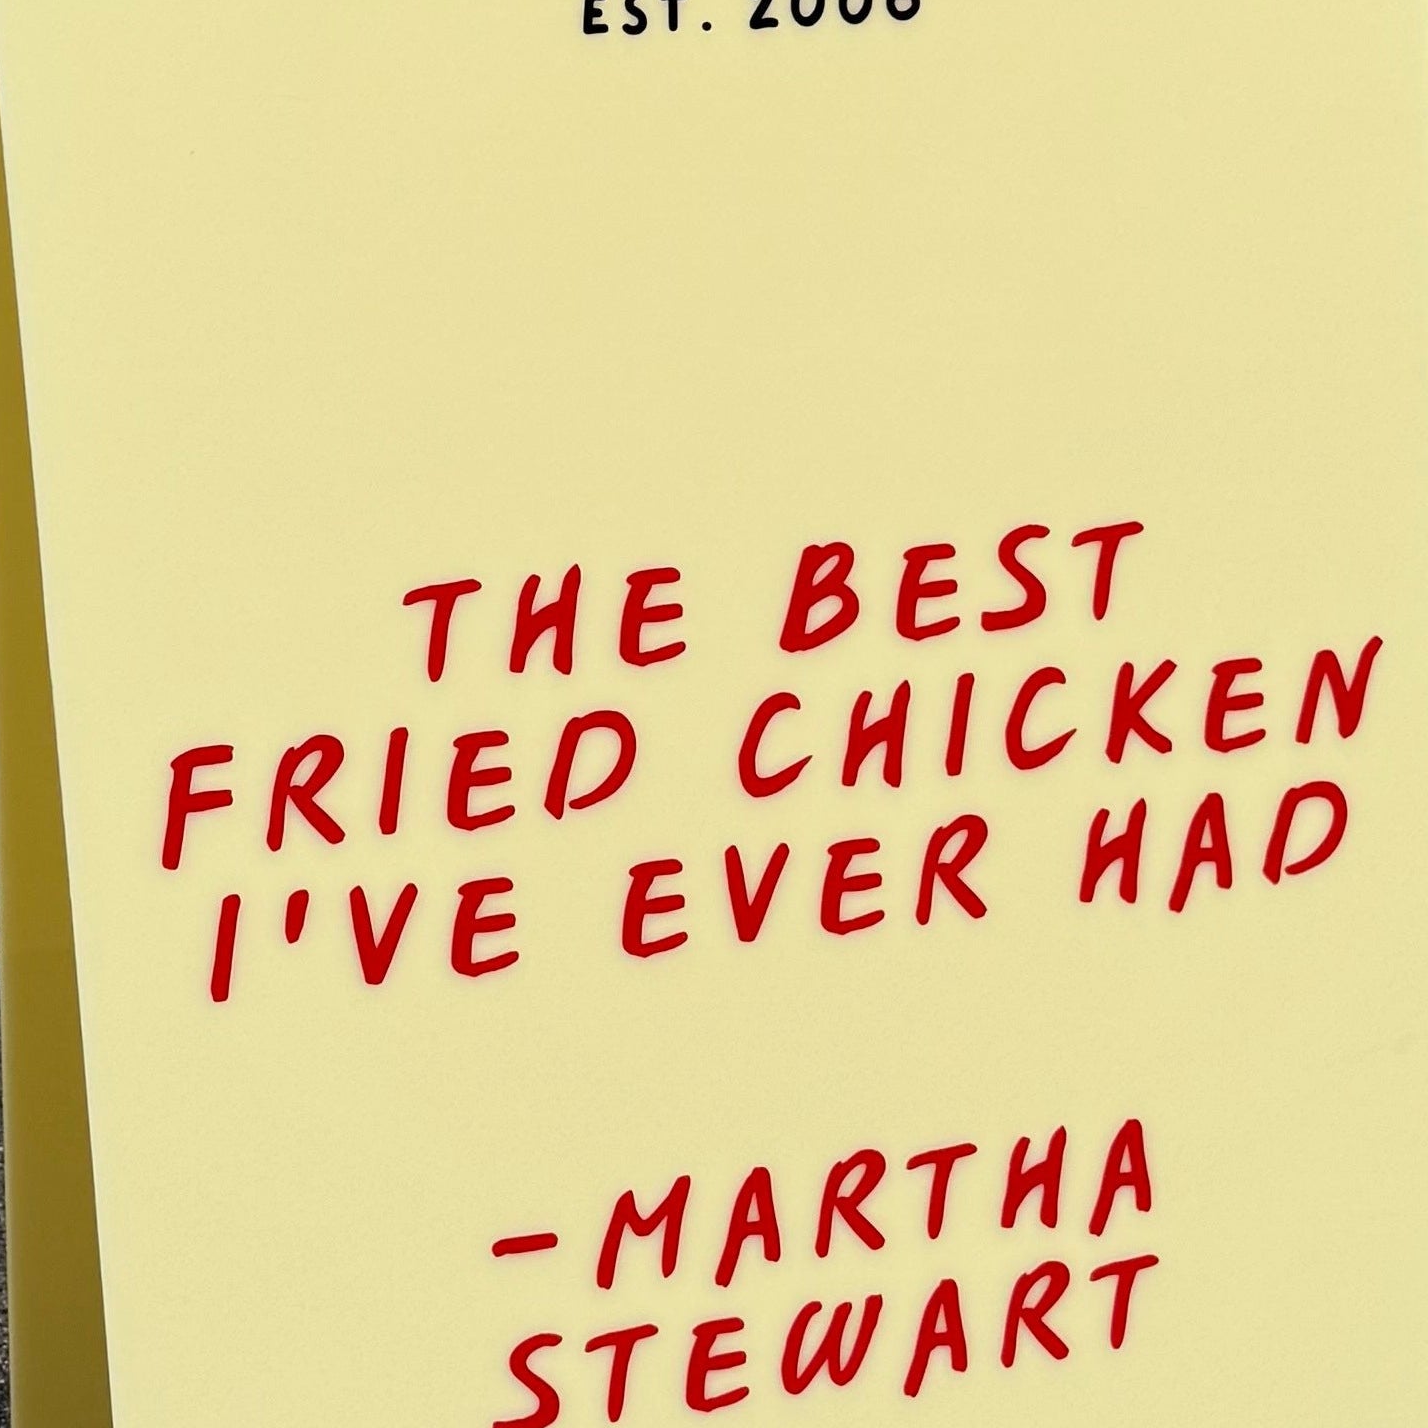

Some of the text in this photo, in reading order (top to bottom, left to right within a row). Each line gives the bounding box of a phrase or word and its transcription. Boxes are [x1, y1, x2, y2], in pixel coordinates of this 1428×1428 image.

[403, 522, 1143, 682] THE BEST
[162, 636, 1382, 870] FRIED CHICKEN
[211, 781, 1347, 1002] I'VE EVER HAD
[492, 1119, 1151, 1289] -MARTHA
